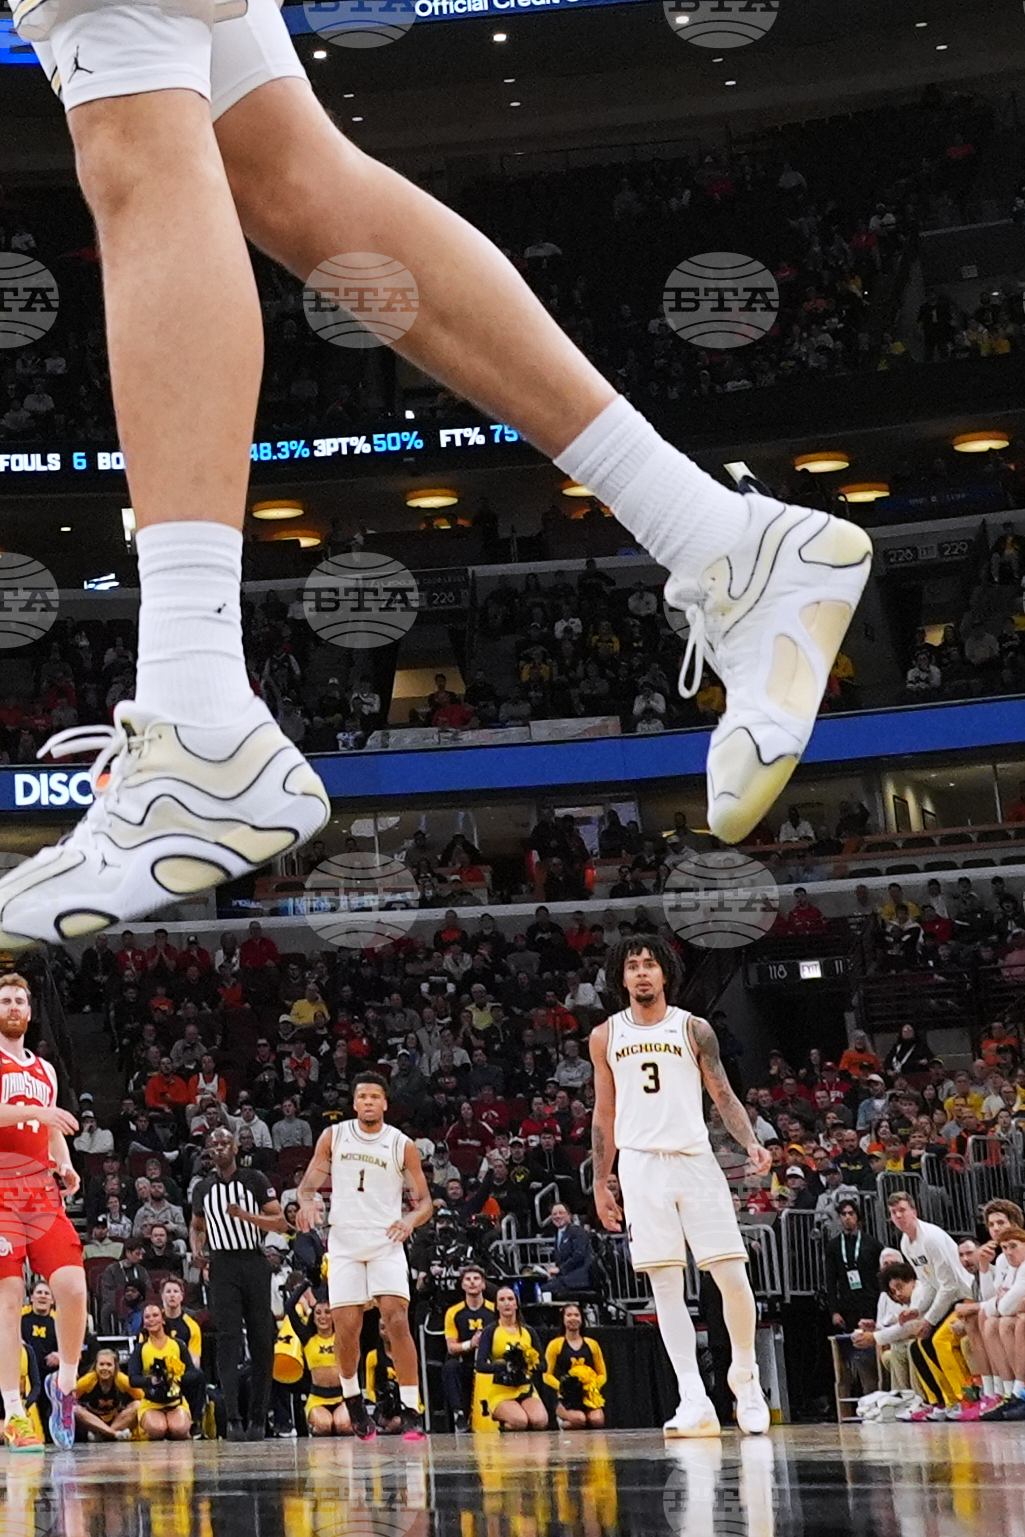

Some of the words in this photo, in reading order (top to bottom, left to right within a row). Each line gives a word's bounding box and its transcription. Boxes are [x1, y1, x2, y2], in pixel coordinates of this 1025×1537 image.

[313, 436, 371, 455] 3PT%
[373, 431, 423, 452] 50%
[440, 427, 484, 447] FT%
[0, 452, 61, 471] FOULS
[73, 452, 87, 470] 6
[615, 1043, 683, 1062] MICHIGAN
[641, 1061, 660, 1094] 3
[340, 1152, 388, 1170] MICHIGAN
[357, 1168, 366, 1192] 1
[32, 1325, 46, 1338] M
